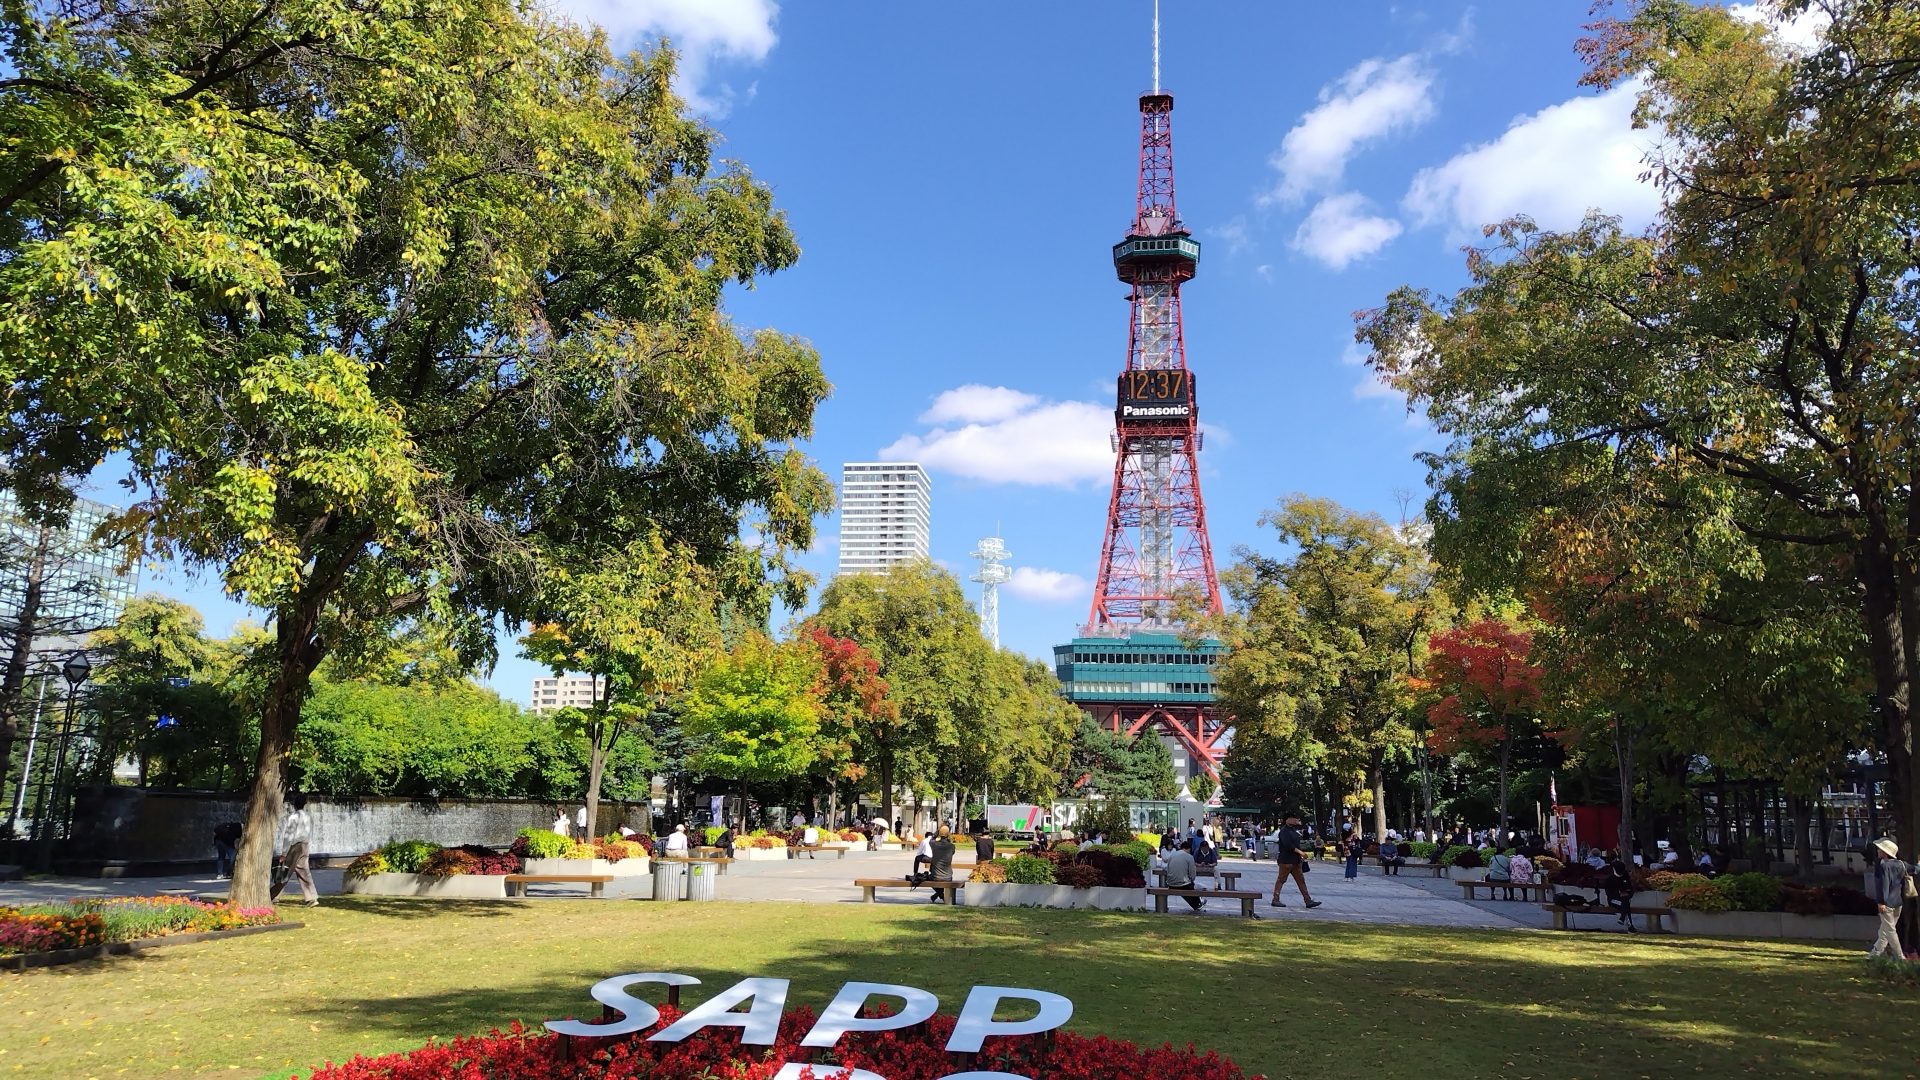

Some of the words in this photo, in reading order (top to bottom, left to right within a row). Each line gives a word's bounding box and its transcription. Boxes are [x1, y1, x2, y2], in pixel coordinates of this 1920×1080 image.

[1128, 371, 1183, 399] 12:37
[1123, 405, 1189, 416] Panasonic
[544, 972, 1074, 1052] SAPP
